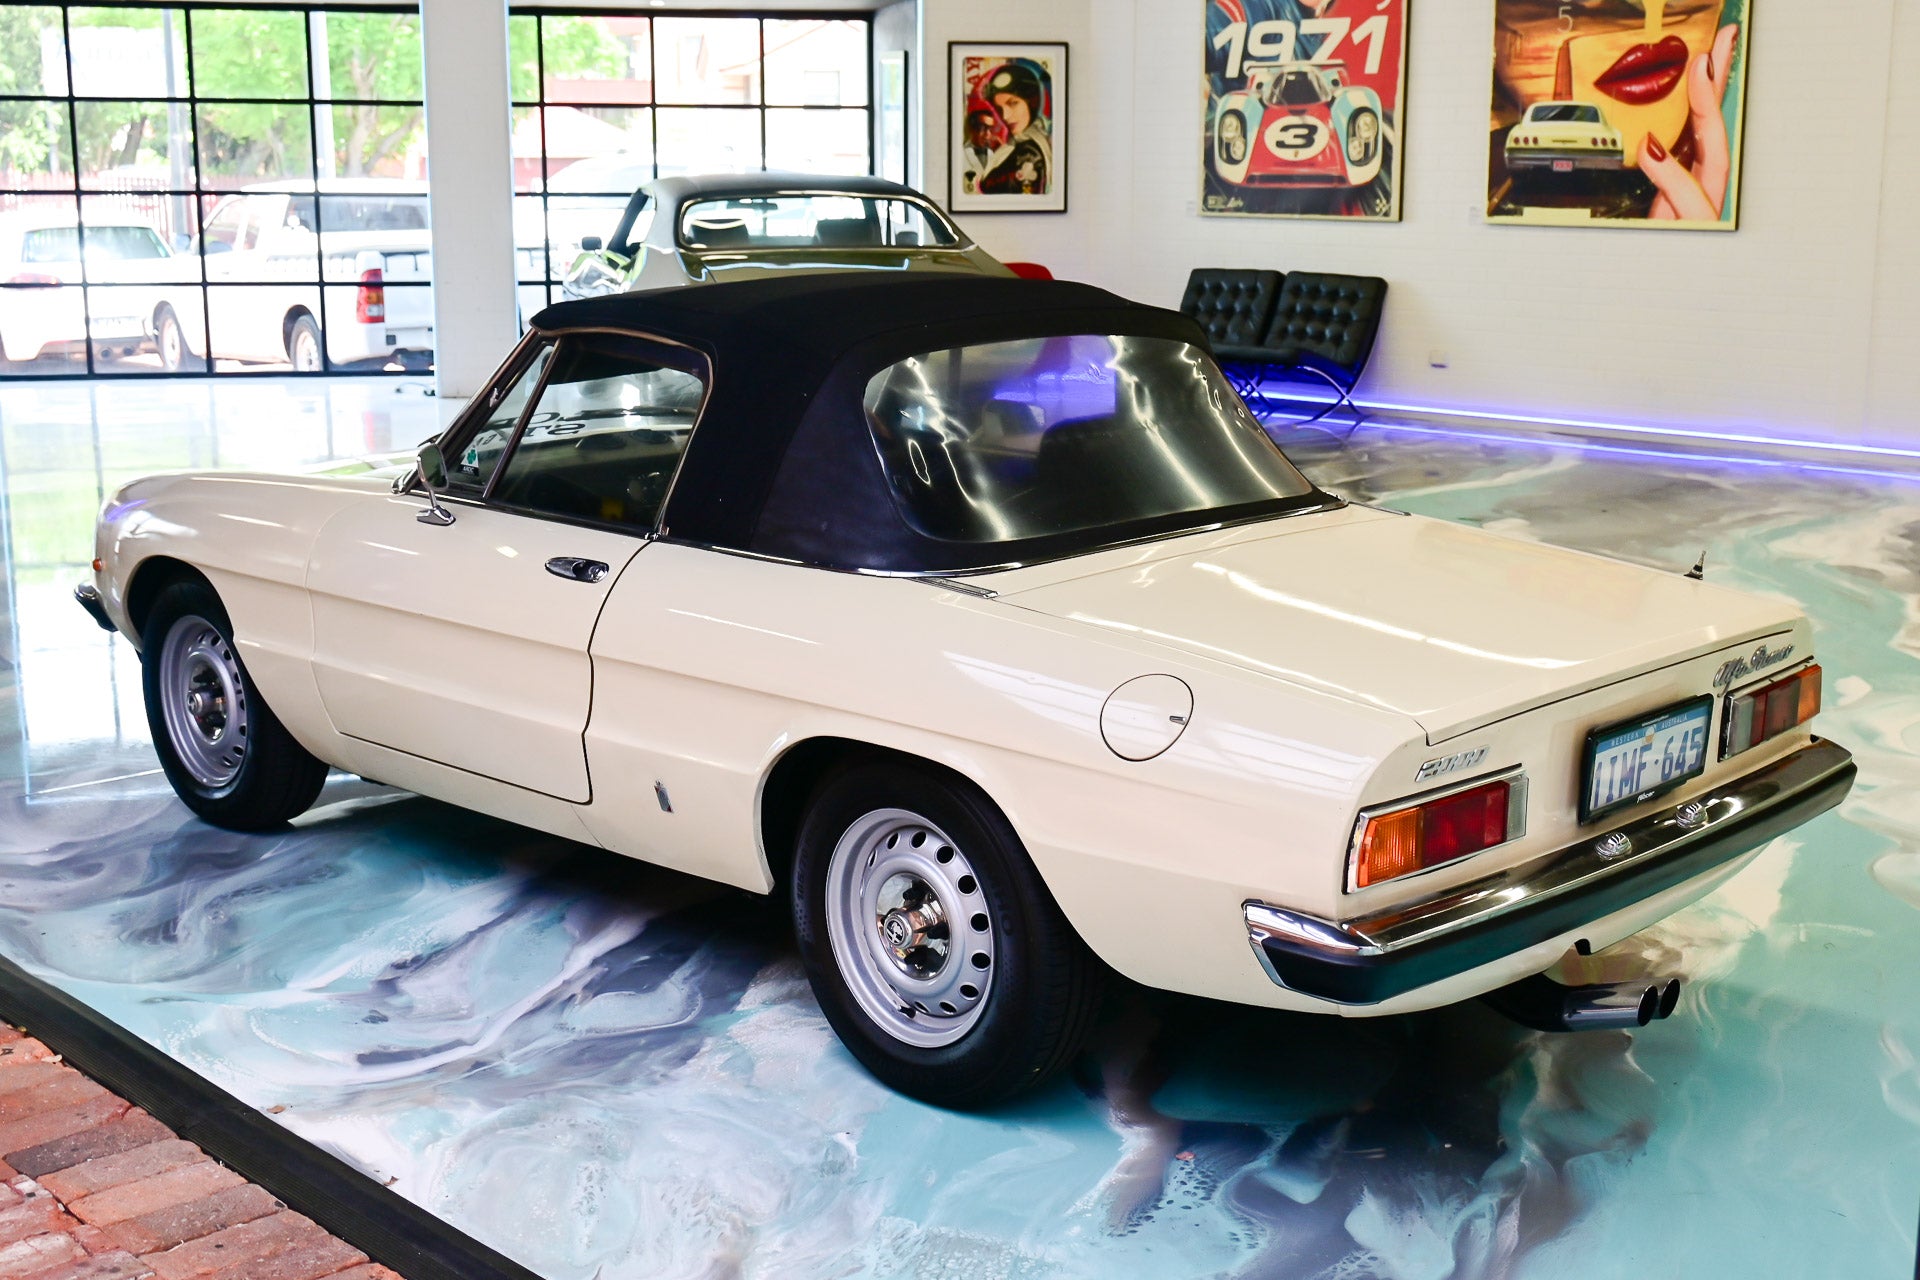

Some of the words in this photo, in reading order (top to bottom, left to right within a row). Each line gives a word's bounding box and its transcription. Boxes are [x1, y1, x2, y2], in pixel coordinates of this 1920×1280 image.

[1213, 15, 1389, 78] 1971
[1275, 124, 1319, 149] 3
[1611, 731, 1639, 748] WESTERN
[1661, 713, 1688, 730] AUSTRALIA
